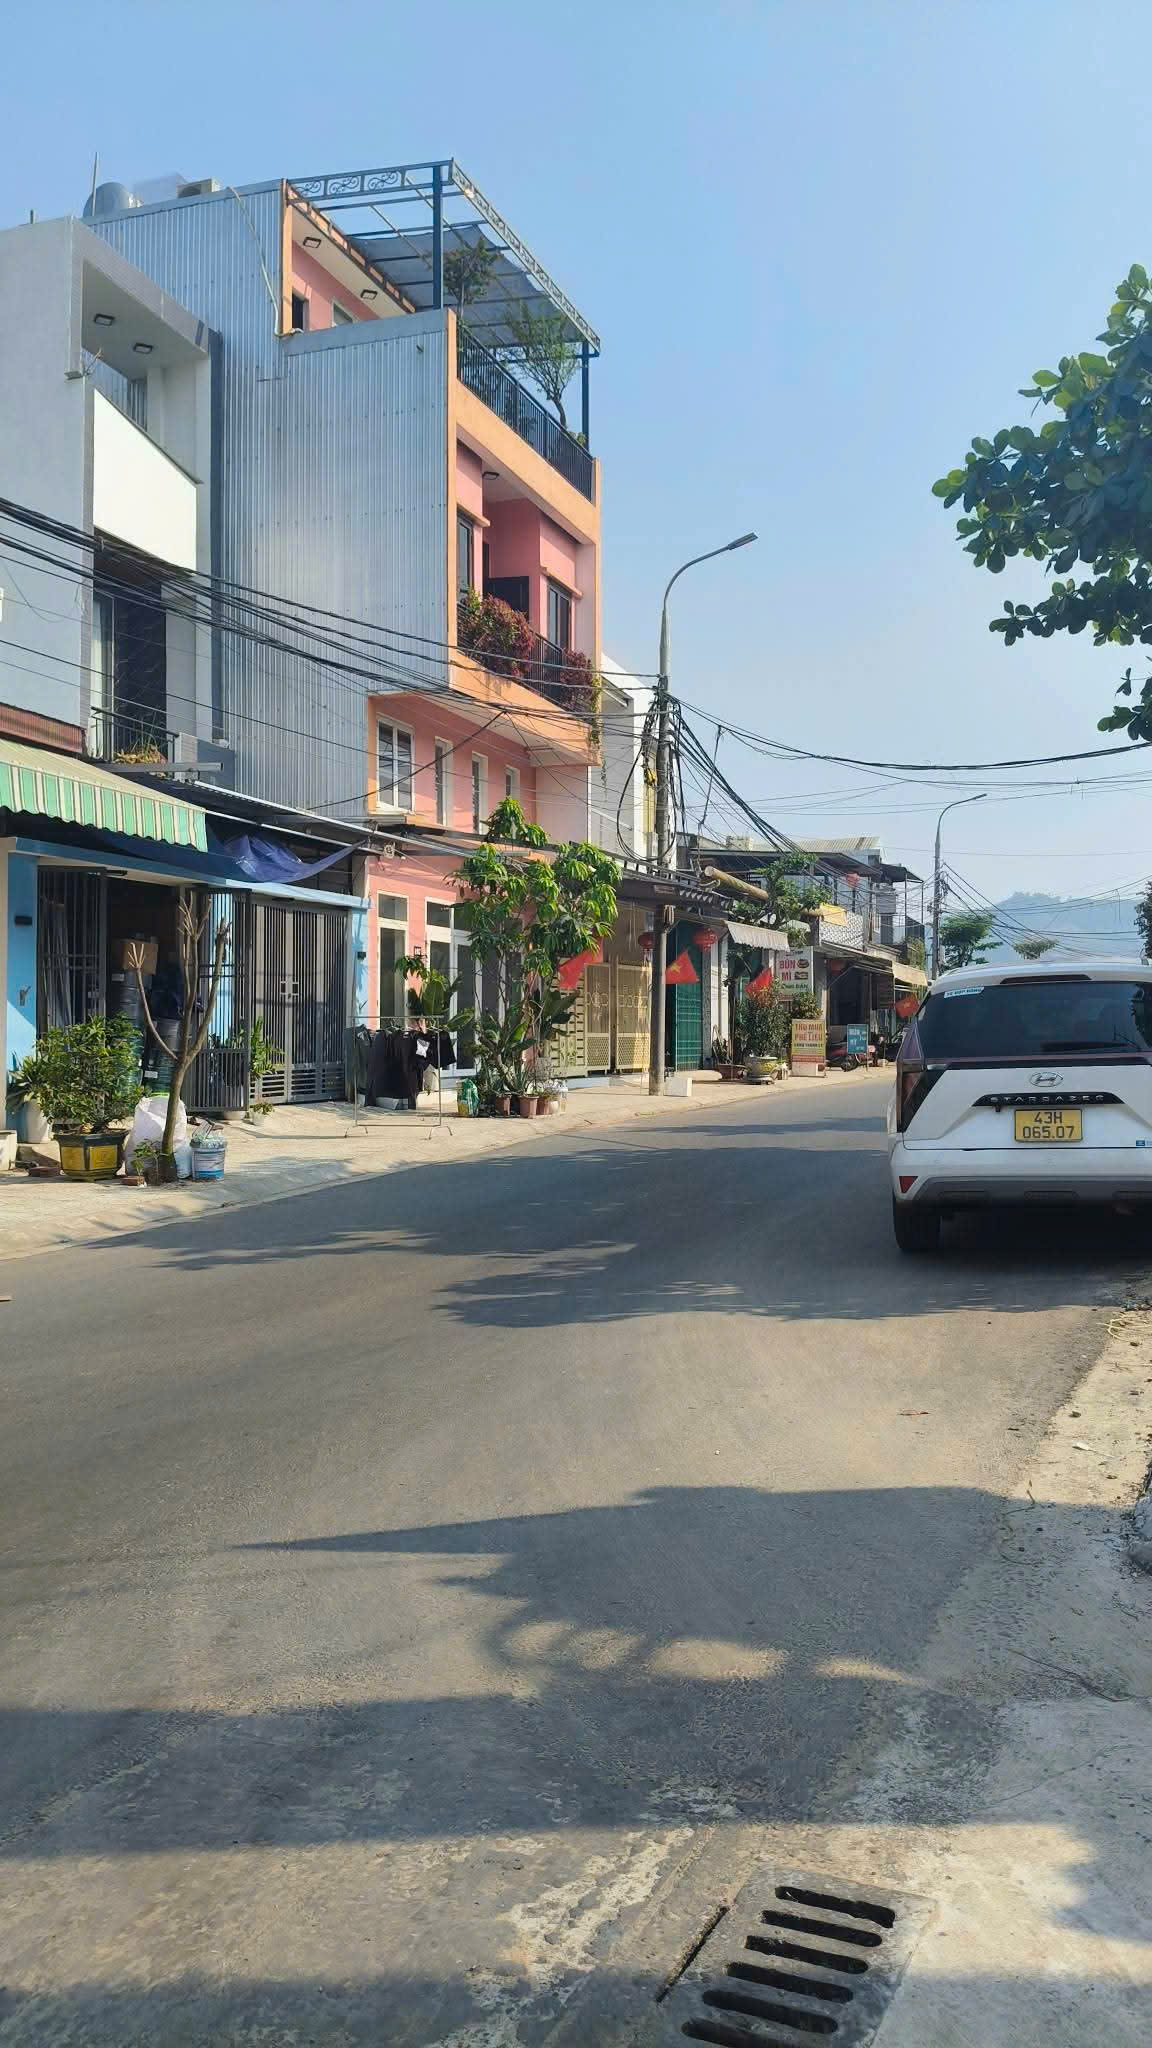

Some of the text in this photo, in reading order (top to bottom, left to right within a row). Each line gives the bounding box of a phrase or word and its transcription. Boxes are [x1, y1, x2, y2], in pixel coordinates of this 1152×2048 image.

[990, 1094, 1104, 1104] STARGAZER
[1034, 1112, 1063, 1124] 43H
[1023, 1126, 1075, 1139] 065.07
